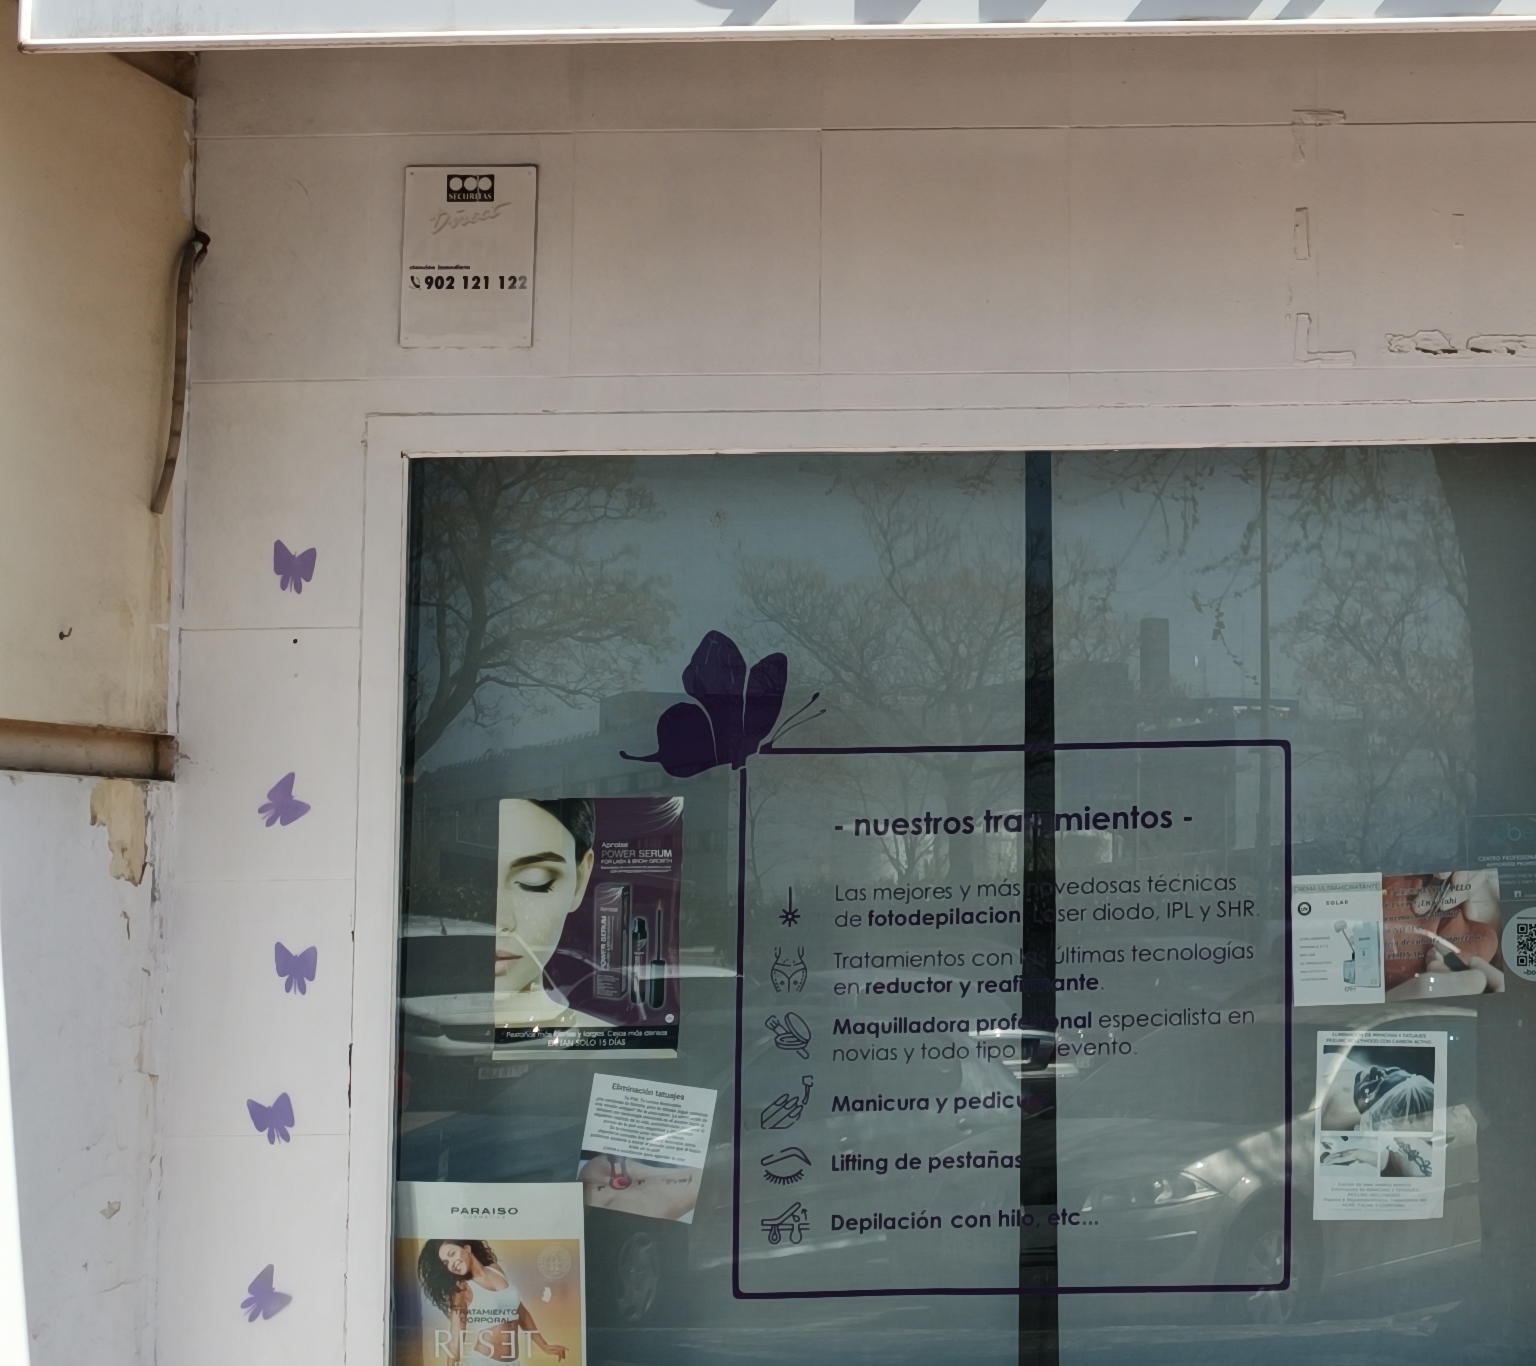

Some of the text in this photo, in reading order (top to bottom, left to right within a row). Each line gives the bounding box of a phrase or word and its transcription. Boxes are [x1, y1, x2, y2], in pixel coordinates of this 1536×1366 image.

[448, 192, 492, 200] SECURITAS
[424, 275, 528, 290] 902 121 122
[854, 810, 975, 837] nuestros
[601, 849, 673, 858] POWER SERUM
[835, 885, 867, 902] Las
[873, 884, 953, 905] mejores
[959, 887, 971, 906] y
[977, 878, 1021, 898] más
[1147, 873, 1237, 894] técnicas
[834, 910, 862, 928] de
[867, 907, 1021, 930] fotodepilacion
[1093, 901, 1160, 923] diodo,
[1166, 901, 1194, 919] IPL
[1200, 904, 1211, 922] y
[834, 950, 966, 970] Tratamientos
[972, 953, 1014, 967] con
[1055, 943, 1125, 965] últimas
[1131, 941, 1255, 965] tecnologías
[833, 973, 1104, 999] en reductor y reafiante.
[832, 1008, 1255, 1038] Maquilladora profeonal especialista en
[575, 1039, 597, 1047] SOLO
[598, 1039, 607, 1047] 15
[608, 1037, 627, 1047] DÍAS
[832, 1043, 898, 1062] novias
[903, 1046, 915, 1065] y
[920, 1041, 970, 1060] todo
[976, 1039, 1016, 1063] tipo
[1056, 1039, 1138, 1057] evento.
[831, 1091, 1050, 1113] Manicura y pedicu
[831, 1150, 1024, 1176] Lifting de pestañas
[450, 1206, 519, 1215] PARAISO
[831, 1210, 943, 1233] Depilación
[950, 1213, 992, 1229] con
[454, 1308, 519, 1316] TRATAMIENTO
[460, 1316, 512, 1324] CORPORAL
